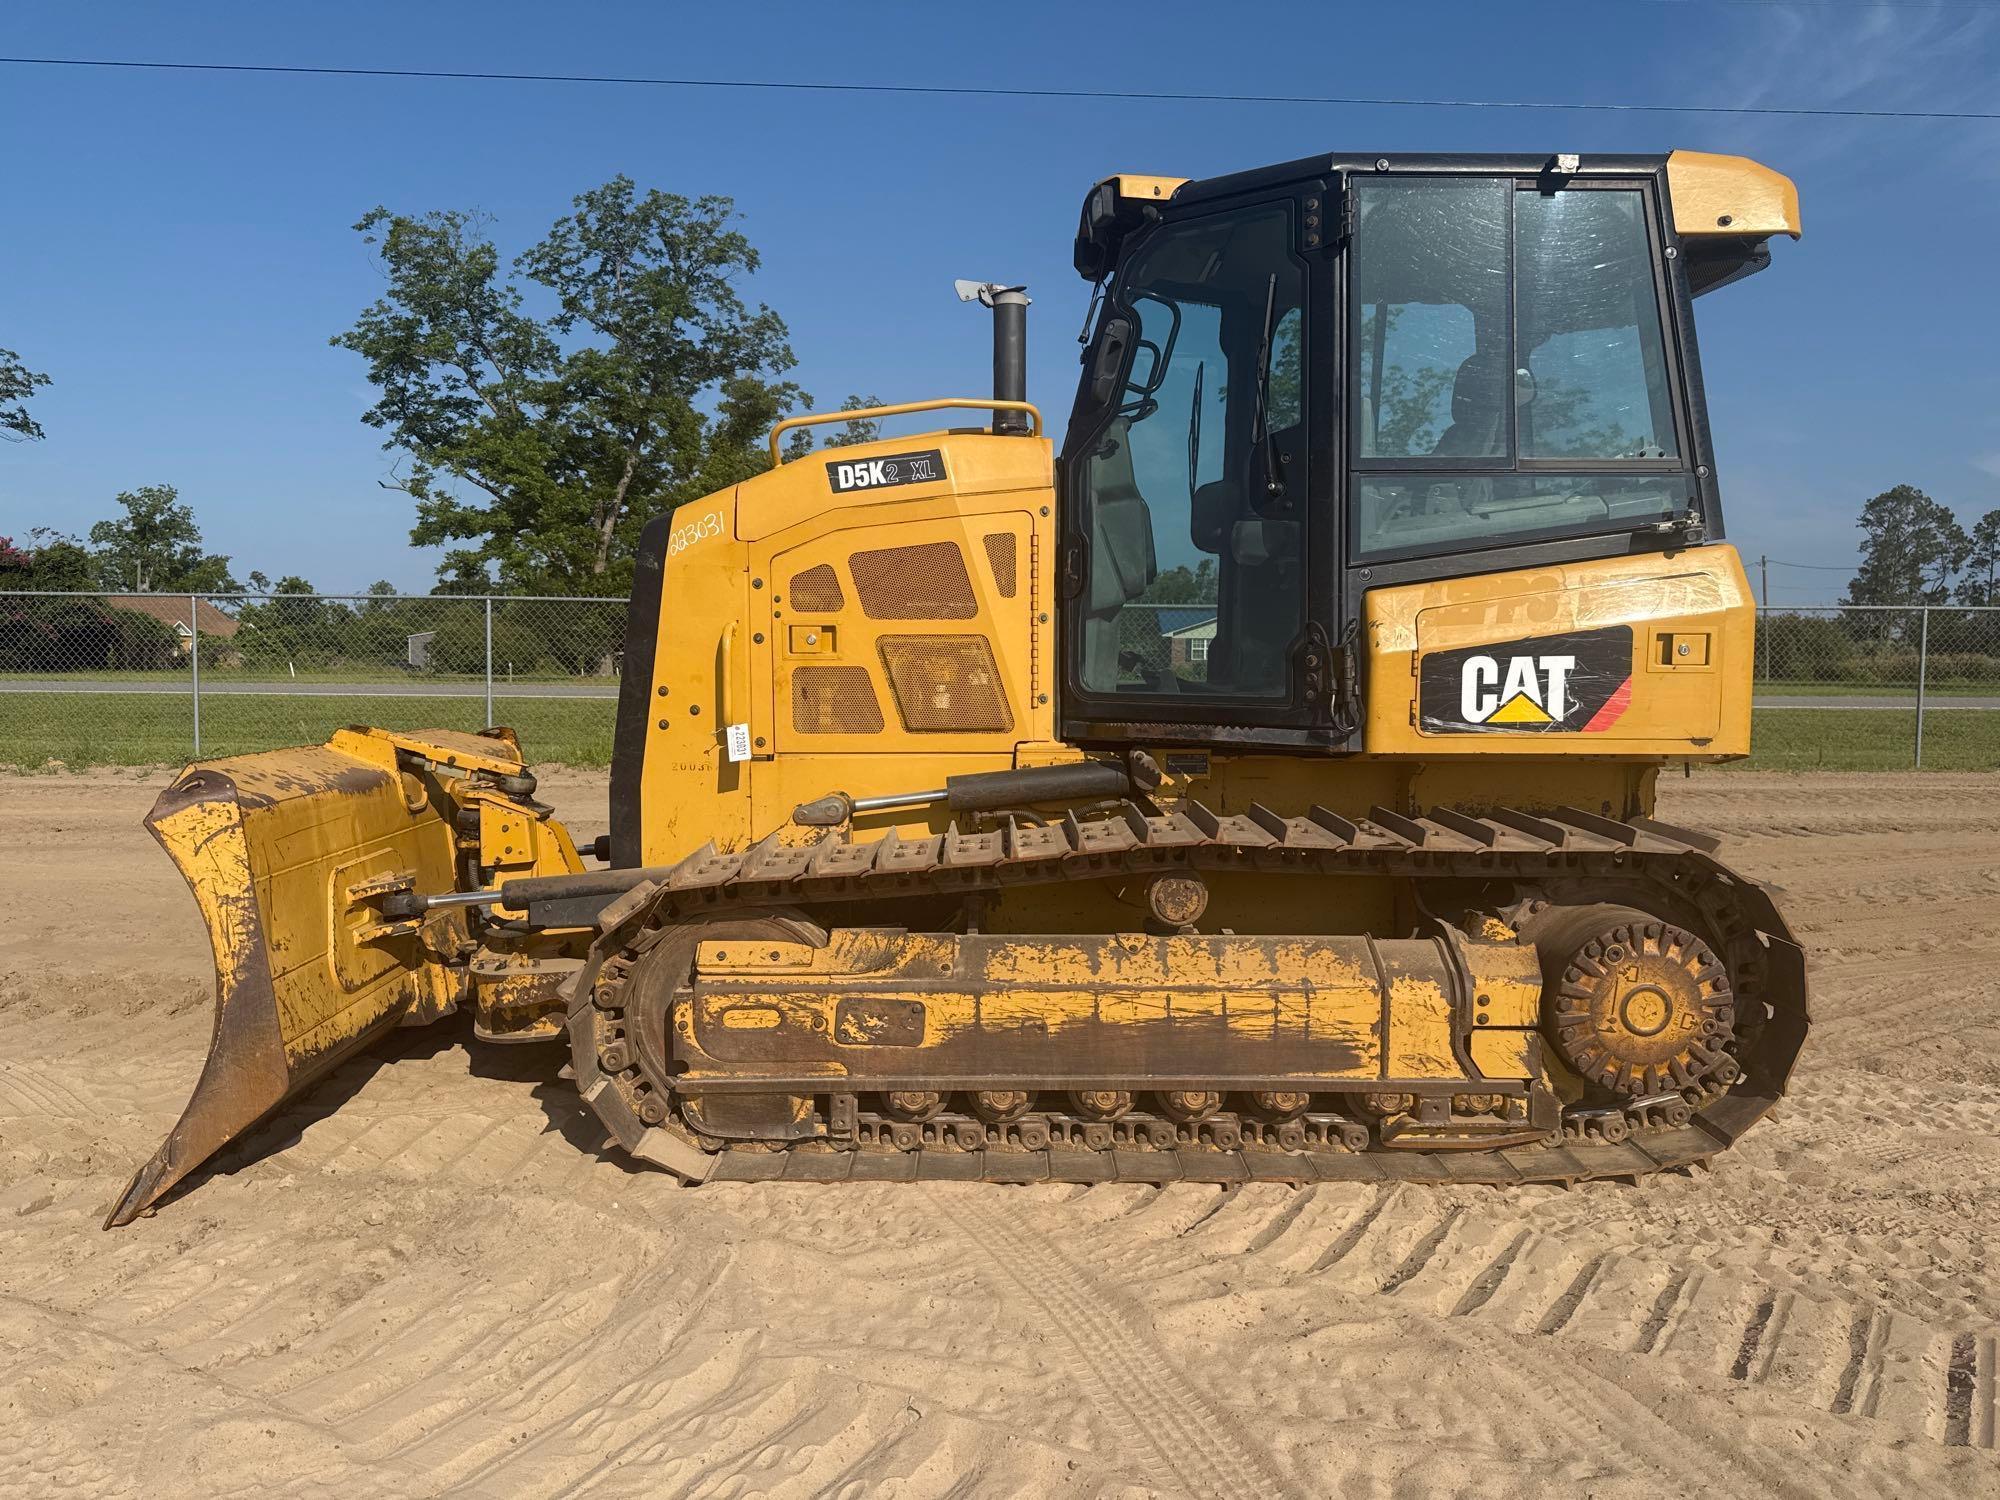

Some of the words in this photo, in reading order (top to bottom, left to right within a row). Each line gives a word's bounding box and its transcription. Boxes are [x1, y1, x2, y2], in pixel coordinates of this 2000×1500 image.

[910, 460, 936, 480] XL
[670, 511, 724, 556] 223031
[1461, 655, 1576, 724] CAT
